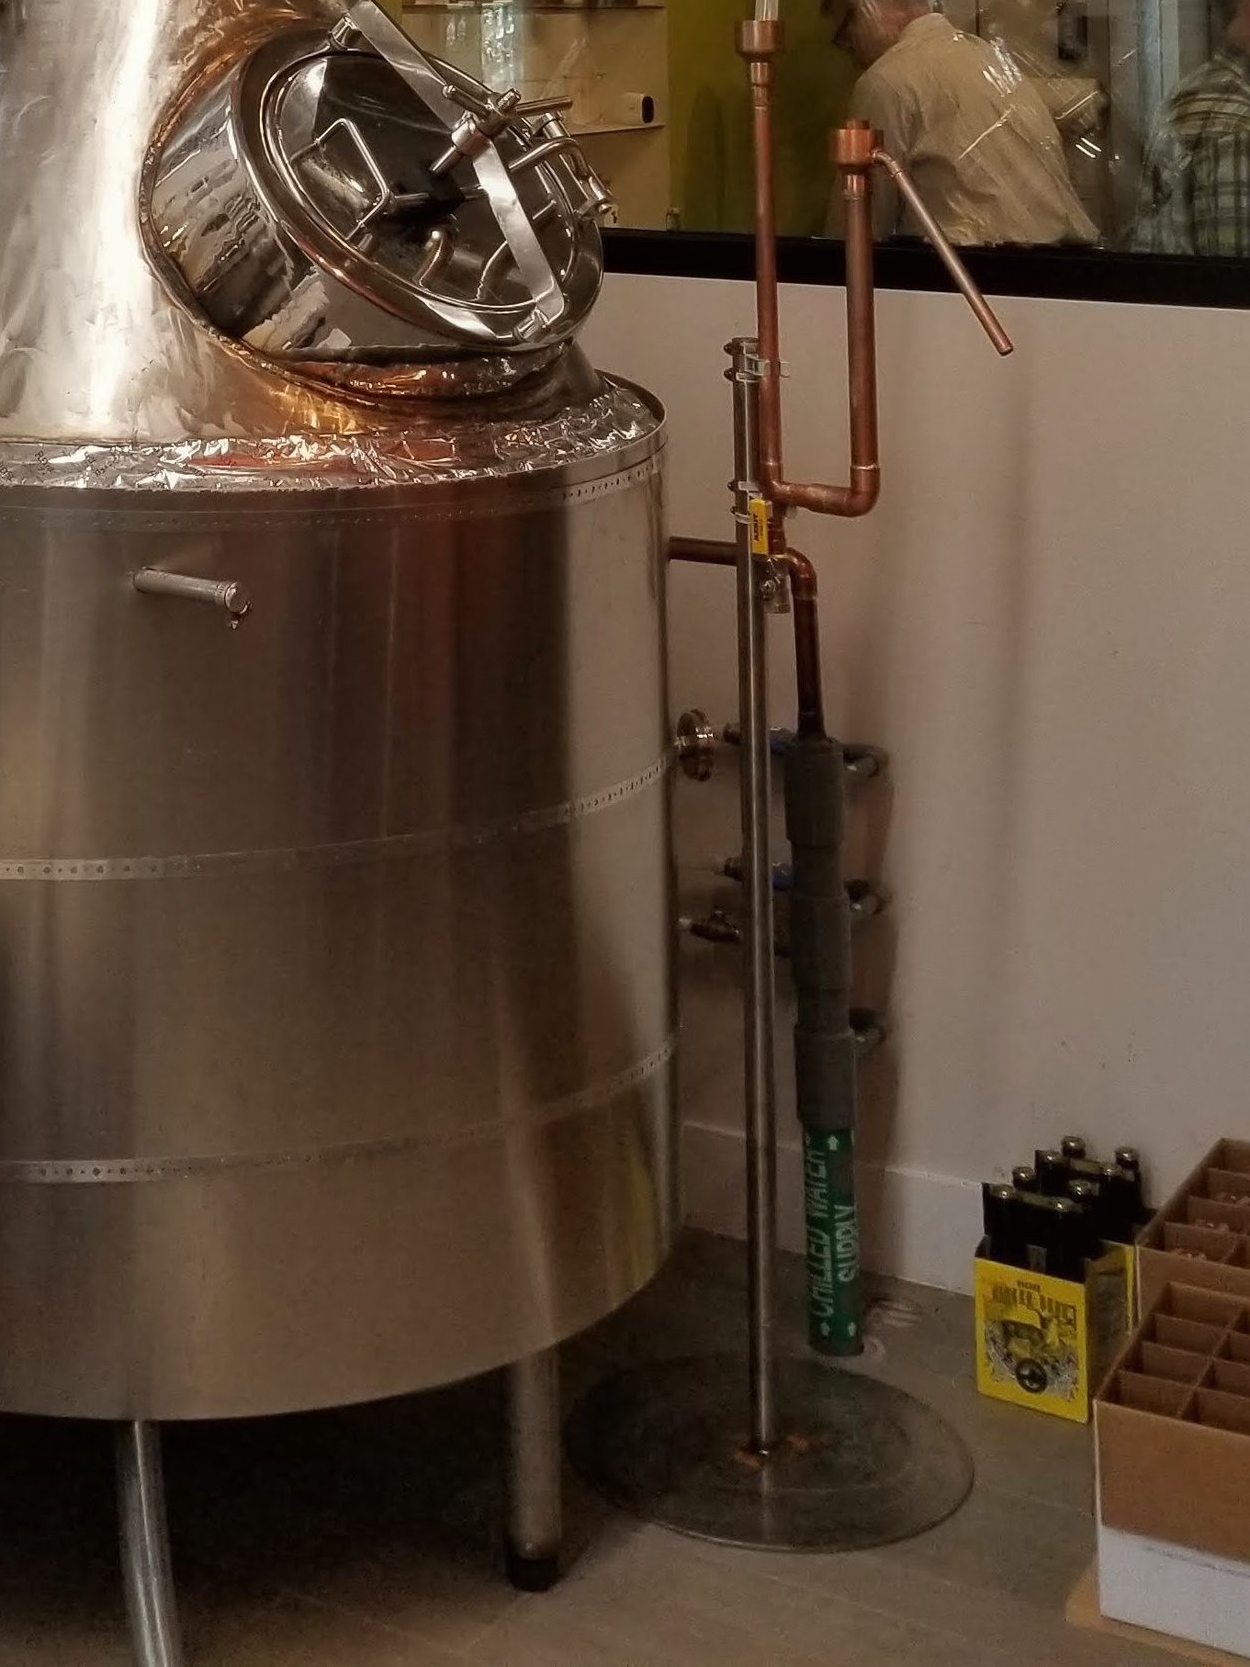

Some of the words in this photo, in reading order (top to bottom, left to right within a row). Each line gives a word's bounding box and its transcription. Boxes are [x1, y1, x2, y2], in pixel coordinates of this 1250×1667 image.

[805, 1149, 829, 1218] WATER
[807, 1228, 834, 1317] CHILLED
[834, 1204, 857, 1283] SUPPLY
